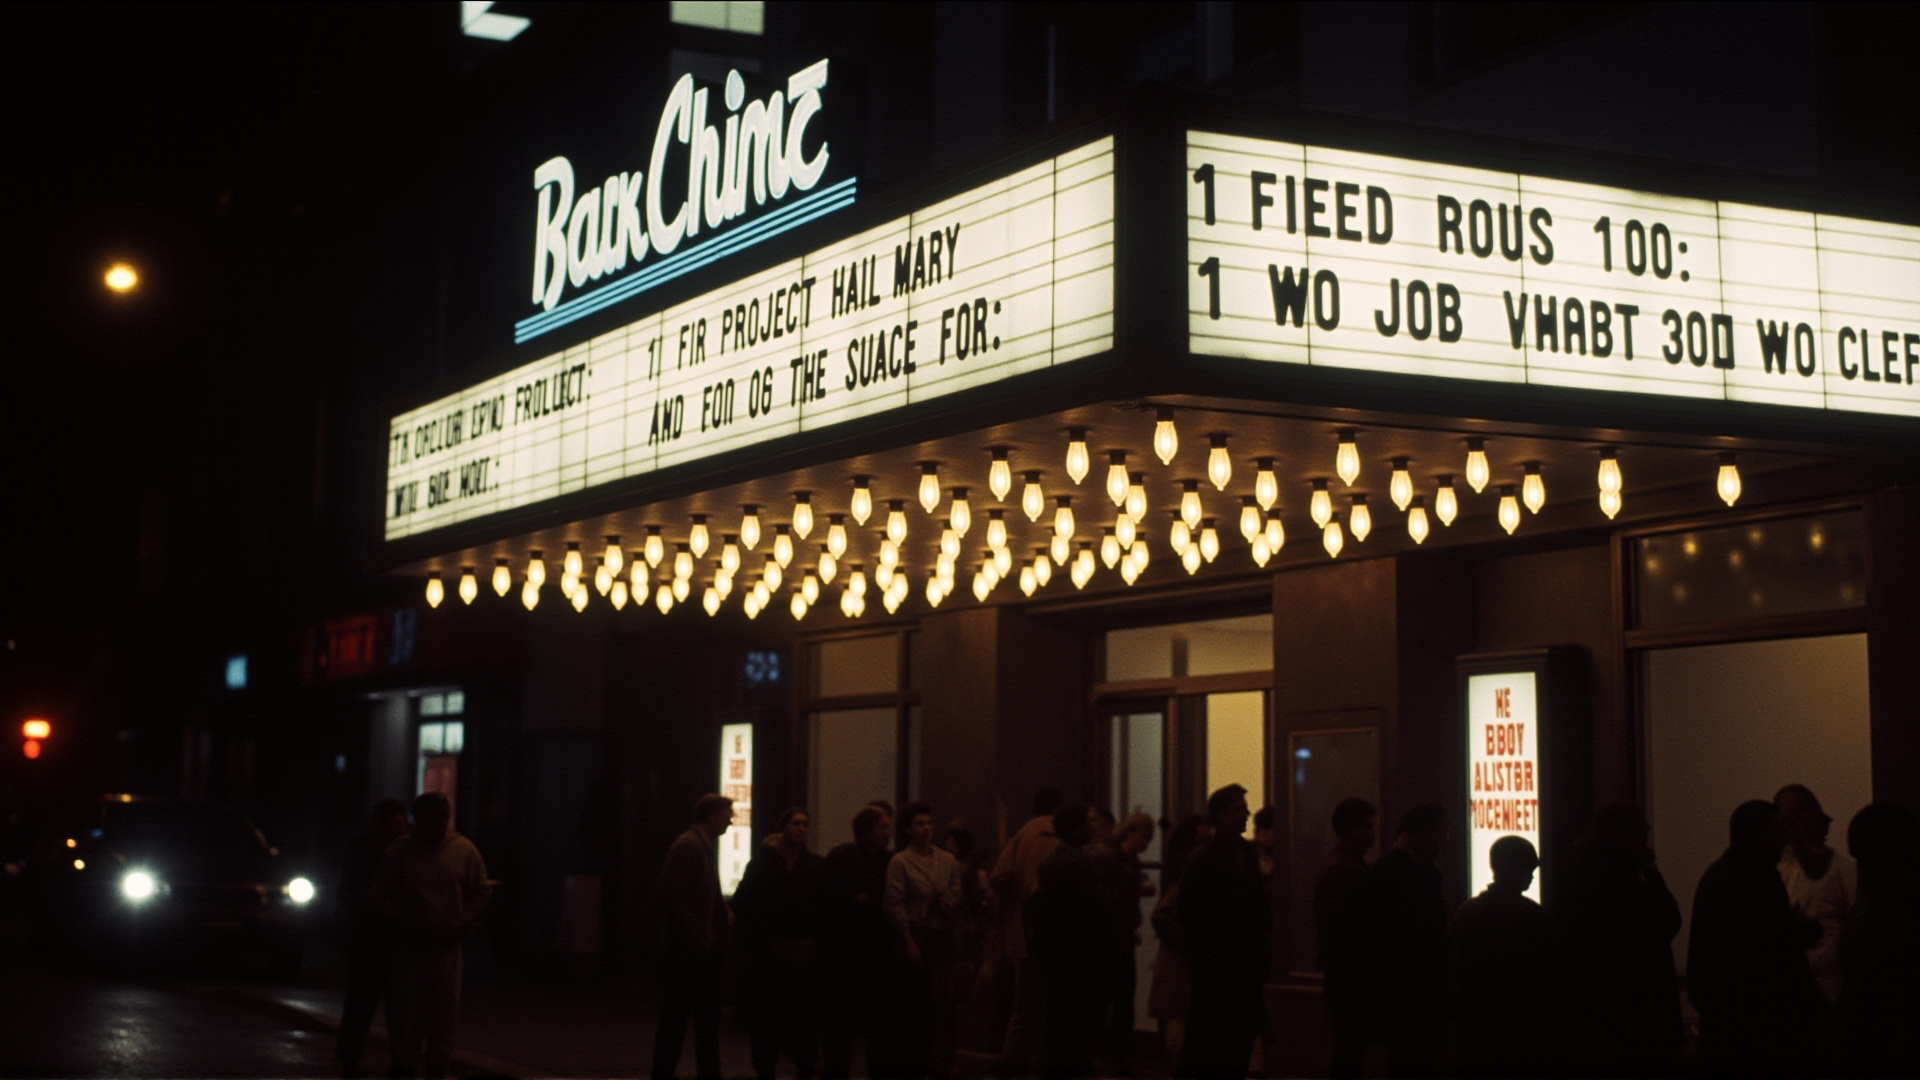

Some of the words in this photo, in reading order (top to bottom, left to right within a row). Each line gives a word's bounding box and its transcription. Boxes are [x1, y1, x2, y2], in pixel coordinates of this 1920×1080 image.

[1193, 163, 1216, 226] 1
[1251, 170, 1394, 245] FIEED
[1437, 194, 1554, 266] ROUS
[1593, 215, 1690, 282] 100:
[720, 277, 817, 355] PROJECT
[831, 254, 881, 320] HAIL
[892, 222, 961, 299] MARY
[1198, 256, 1221, 321] 1
[1268, 263, 1340, 332] WO
[1374, 278, 1463, 344] JOB
[1756, 318, 1816, 378] WO
[790, 349, 828, 408] THE
[845, 320, 918, 392] SUACE
[939, 297, 1002, 366] FOR:
